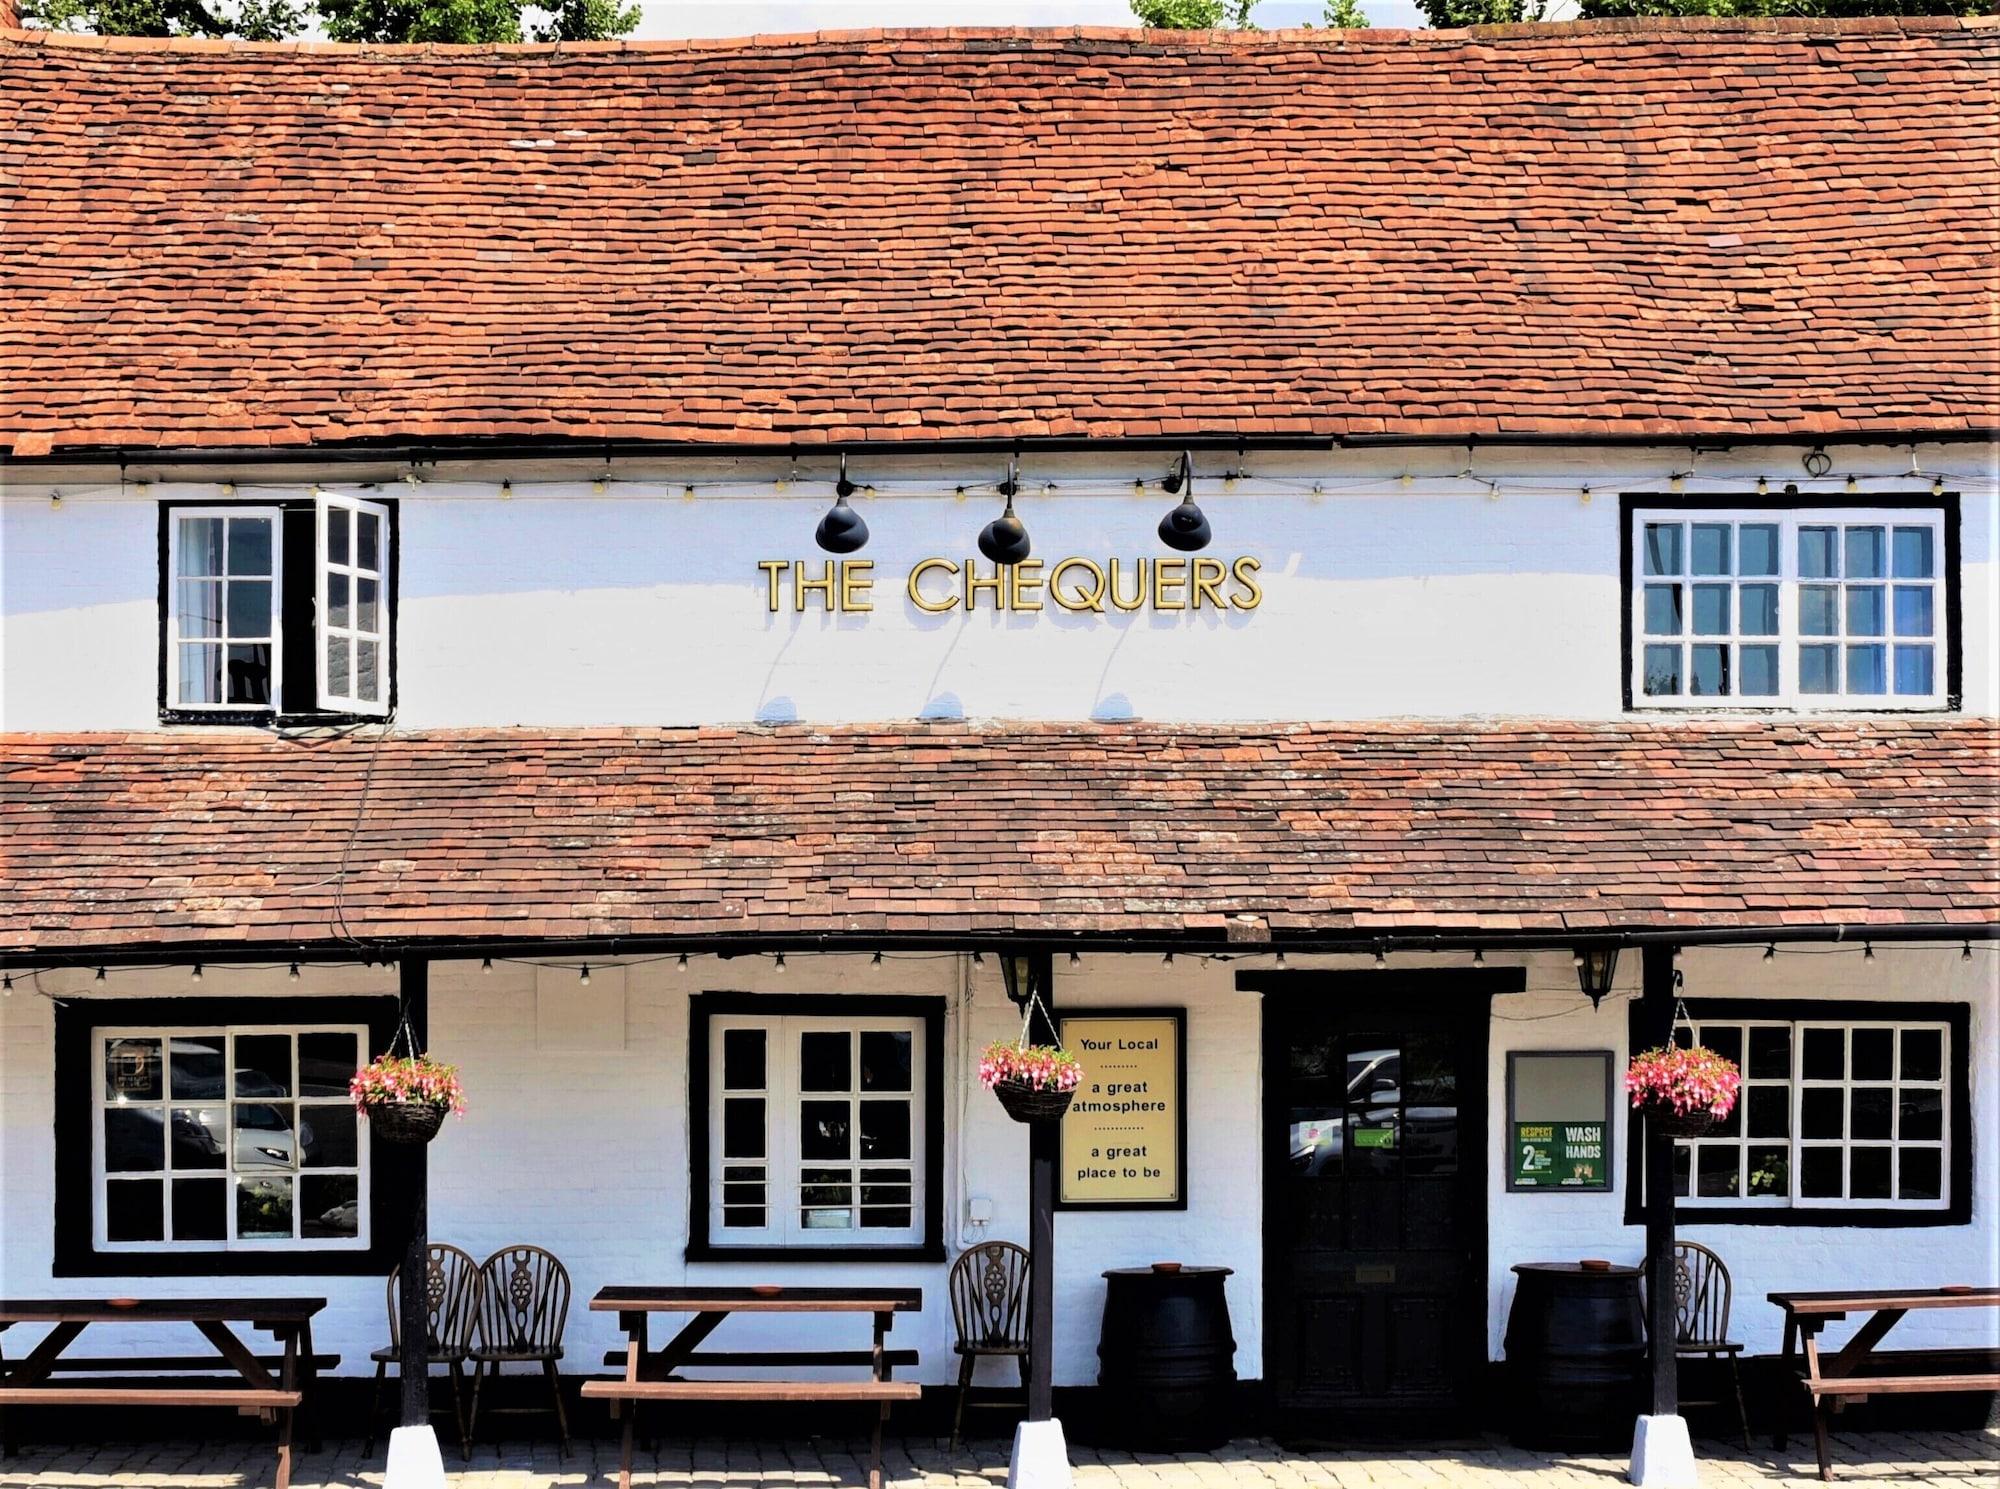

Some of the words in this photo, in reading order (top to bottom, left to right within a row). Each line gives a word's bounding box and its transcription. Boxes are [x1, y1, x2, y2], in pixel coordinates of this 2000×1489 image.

[757, 560, 874, 612] THE
[908, 556, 1262, 613] CHEQUERS
[1080, 1038, 1112, 1050] Your
[1118, 1038, 1158, 1050] Local
[1091, 1083, 1100, 1093] a
[1107, 1082, 1148, 1095] great
[1072, 1100, 1166, 1114] atmosphere
[1520, 1126, 1553, 1137] RESPECT
[1565, 1126, 1601, 1142] WASH
[1091, 1148, 1100, 1158] a
[1106, 1146, 1147, 1160] great
[1522, 1145, 1535, 1170] 2
[1565, 1145, 1601, 1159] HANDS
[1077, 1167, 1117, 1181] place
[1122, 1168, 1137, 1178] to
[1143, 1167, 1161, 1178] be
